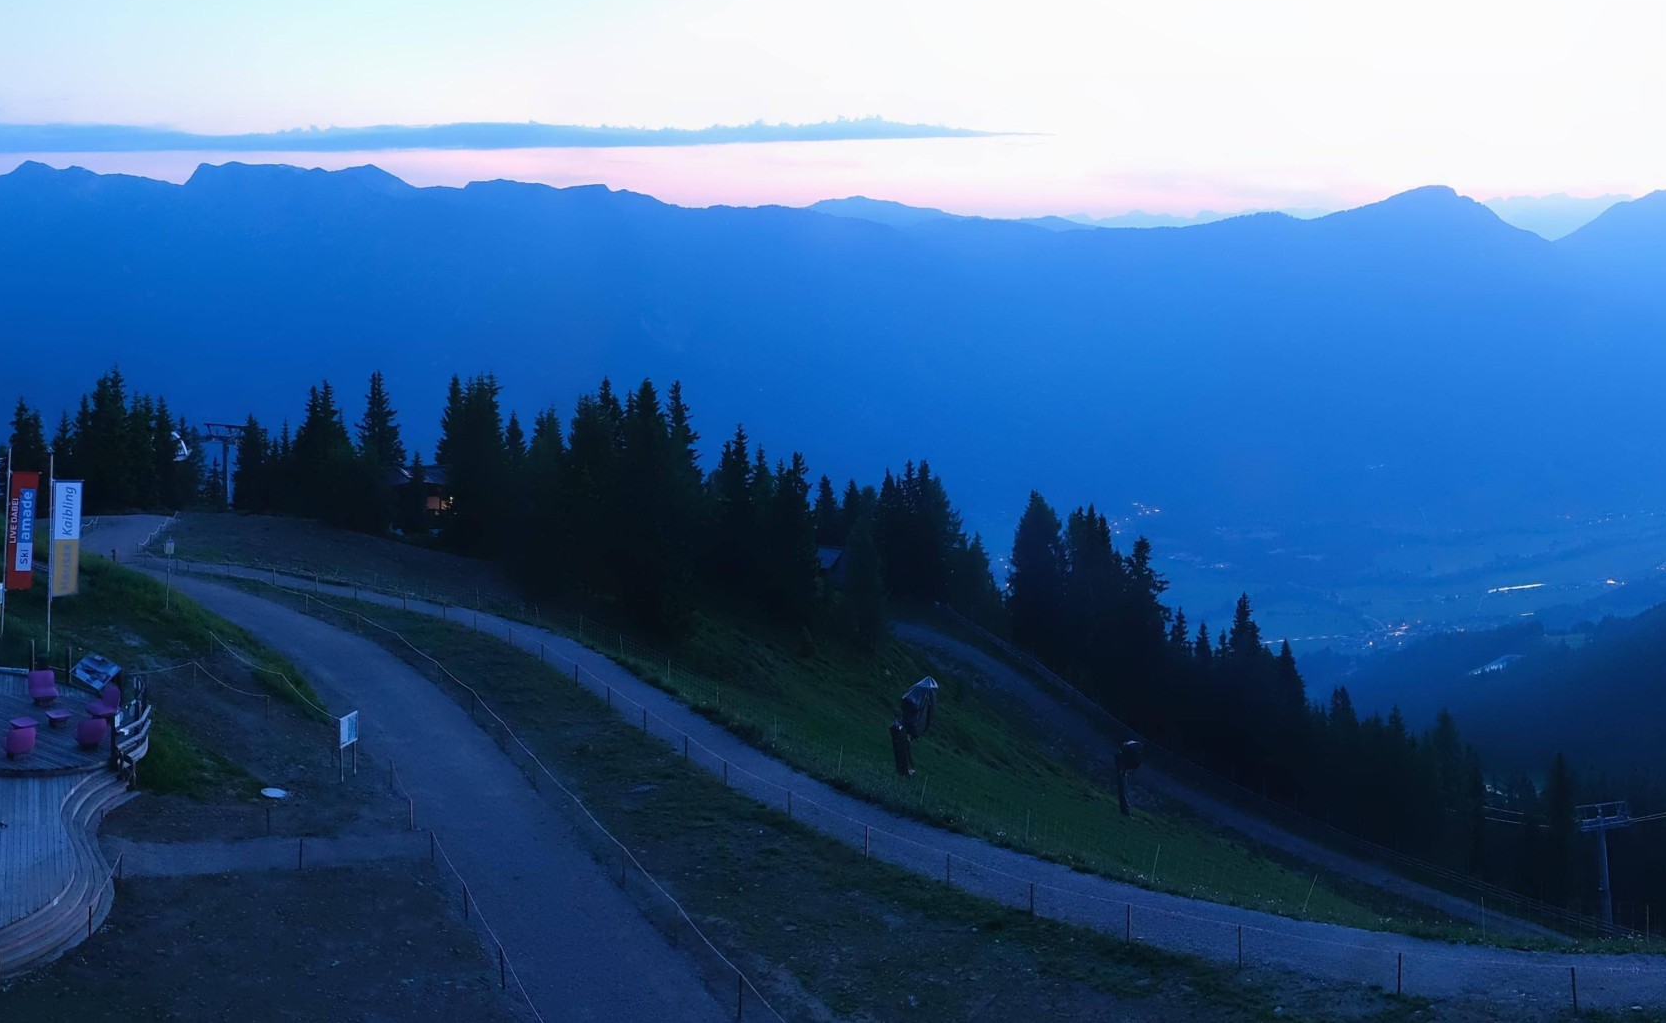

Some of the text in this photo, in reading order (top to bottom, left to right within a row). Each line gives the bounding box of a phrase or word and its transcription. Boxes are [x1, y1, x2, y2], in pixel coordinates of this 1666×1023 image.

[9, 497, 19, 544] LIVE DABEI
[62, 485, 77, 536] Kaibling
[19, 549, 29, 565] Ski
